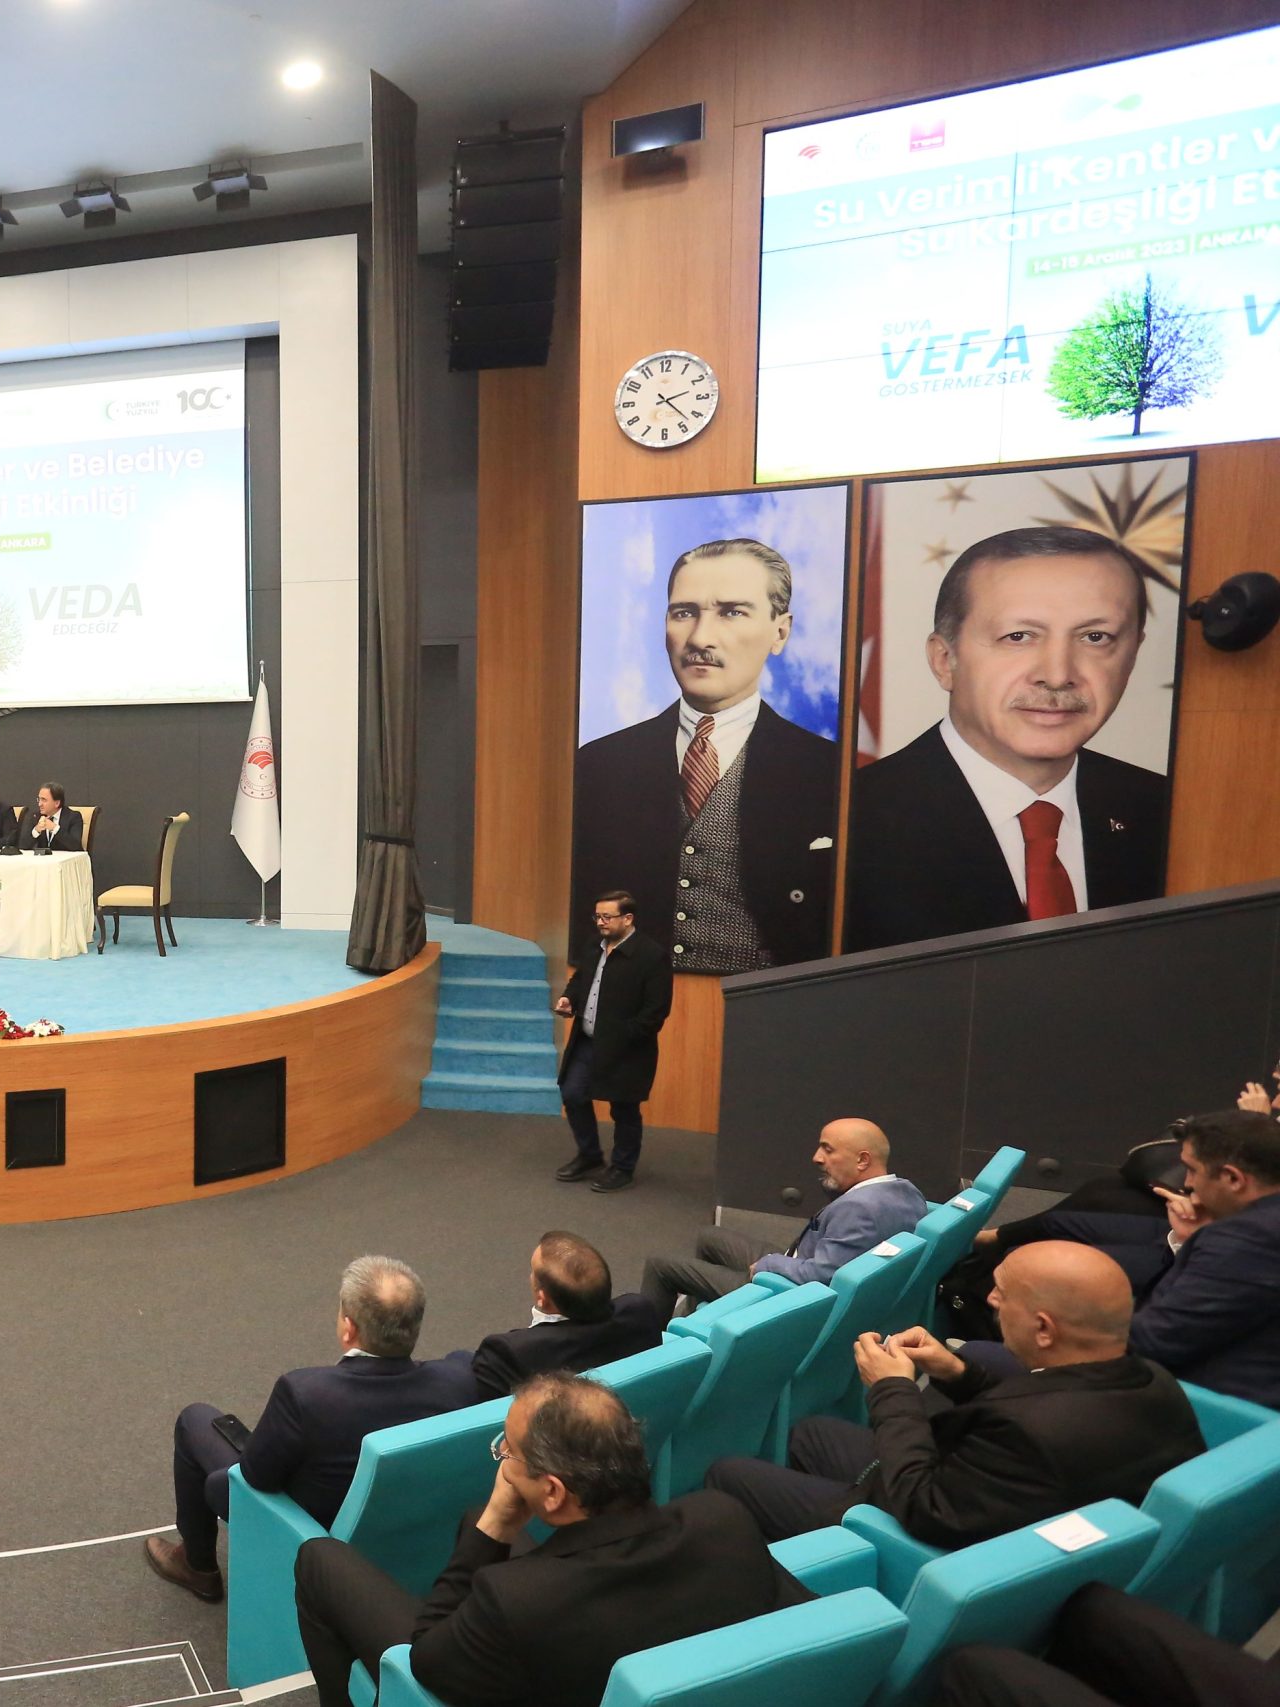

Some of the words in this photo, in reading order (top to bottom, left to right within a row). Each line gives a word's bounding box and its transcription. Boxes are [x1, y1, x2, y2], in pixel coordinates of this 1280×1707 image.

[815, 199, 865, 228] Su
[878, 159, 1039, 216] Verimli
[1051, 131, 1240, 190] Kentler
[900, 229, 956, 257] Su
[971, 174, 1217, 248] Kardeşliği
[1141, 240, 1186, 257] 2023
[881, 319, 933, 336] SUYA
[880, 323, 1031, 380] VEFA
[641, 366, 654, 380] 11
[660, 360, 671, 373] 12
[681, 363, 690, 375] 1
[626, 380, 641, 393] 10
[691, 374, 705, 386] 2
[879, 369, 1034, 400] GÖSTERMEZSEK
[696, 393, 710, 401] 3
[627, 416, 640, 426] 8
[691, 410, 704, 419] 4
[641, 425, 651, 437] 7
[677, 421, 689, 433] 5
[661, 428, 668, 440] 6
[24, 459, 60, 482] ve
[67, 443, 205, 481] Belediye
[16, 483, 138, 521] Etkinliği
[0, 537, 47, 550] ANKARA
[28, 582, 144, 621] VEDA
[51, 620, 120, 637] EDECEĞİZ
